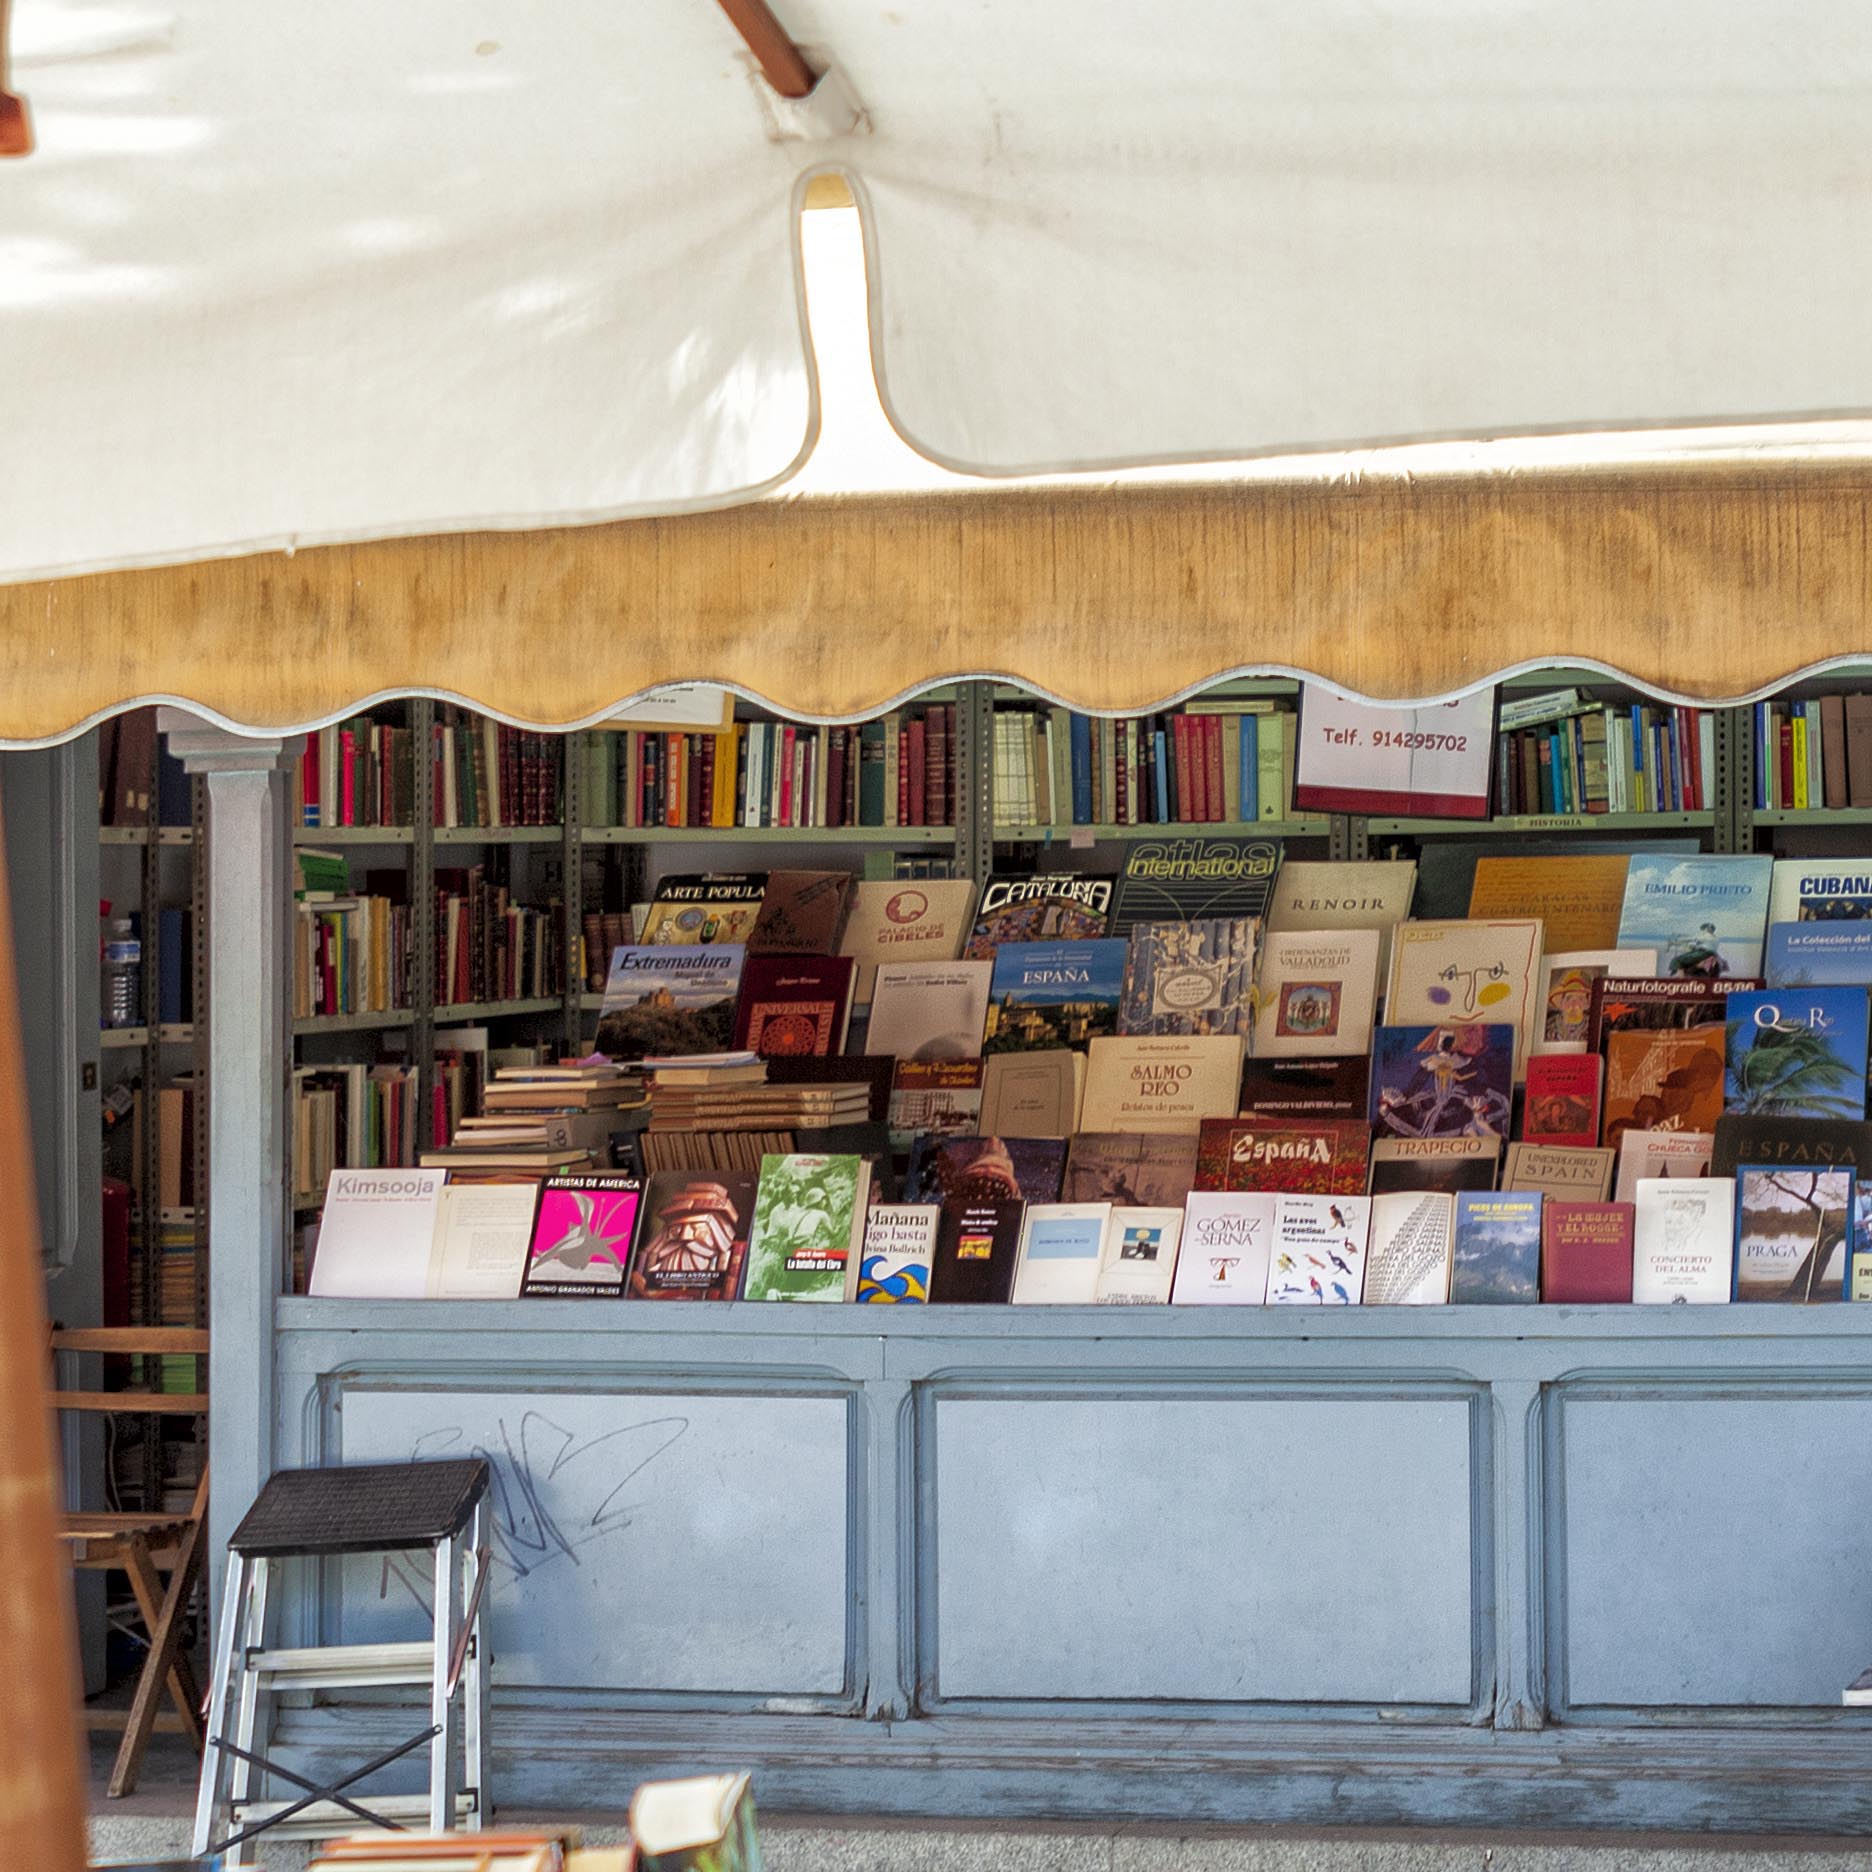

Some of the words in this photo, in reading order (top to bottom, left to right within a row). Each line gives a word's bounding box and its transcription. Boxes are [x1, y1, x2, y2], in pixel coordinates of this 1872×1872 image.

[1323, 727, 1363, 746] Telf.
[1372, 730, 1468, 752] 914295702
[1529, 819, 1582, 827] HISTORIA
[1128, 855, 1276, 878] international
[1129, 840, 1277, 881] atlas
[660, 886, 703, 900] ARTE
[707, 885, 766, 899] POPULA
[1644, 883, 1698, 895] EMILIO
[981, 880, 1113, 915] CATALUÑA
[1292, 897, 1385, 912] RENOIR
[877, 930, 945, 945] CIBELES
[1788, 936, 1800, 945] La
[1802, 934, 1852, 945] Colección
[1854, 934, 1871, 944] del
[619, 952, 733, 972] Extremadura
[1023, 967, 1090, 985] ESPAÑA
[1603, 978, 1706, 996] Naturfotografie
[1130, 1063, 1193, 1081] SALMO
[1140, 1081, 1181, 1097] REO
[1393, 1140, 1482, 1157] TRAPECIO
[1739, 1139, 1857, 1164] ESPAÑA
[1528, 1152, 1598, 1167] UNEXPLORED
[1524, 1164, 1596, 1180] SPAIN
[336, 1176, 434, 1197] Kimsooja
[546, 1176, 586, 1188] ARTISTAS
[586, 1178, 599, 1188] DE
[866, 1209, 929, 1227] Mañana
[1299, 1216, 1317, 1224] aves
[891, 1227, 928, 1241] basta
[1281, 1225, 1326, 1235] argentinas
[1200, 1232, 1254, 1247] SERNA
[865, 1242, 887, 1253] lvina
[1746, 1244, 1799, 1258] PRAGA
[1655, 1264, 1676, 1274] DEL
[1678, 1264, 1707, 1274] ALMA
